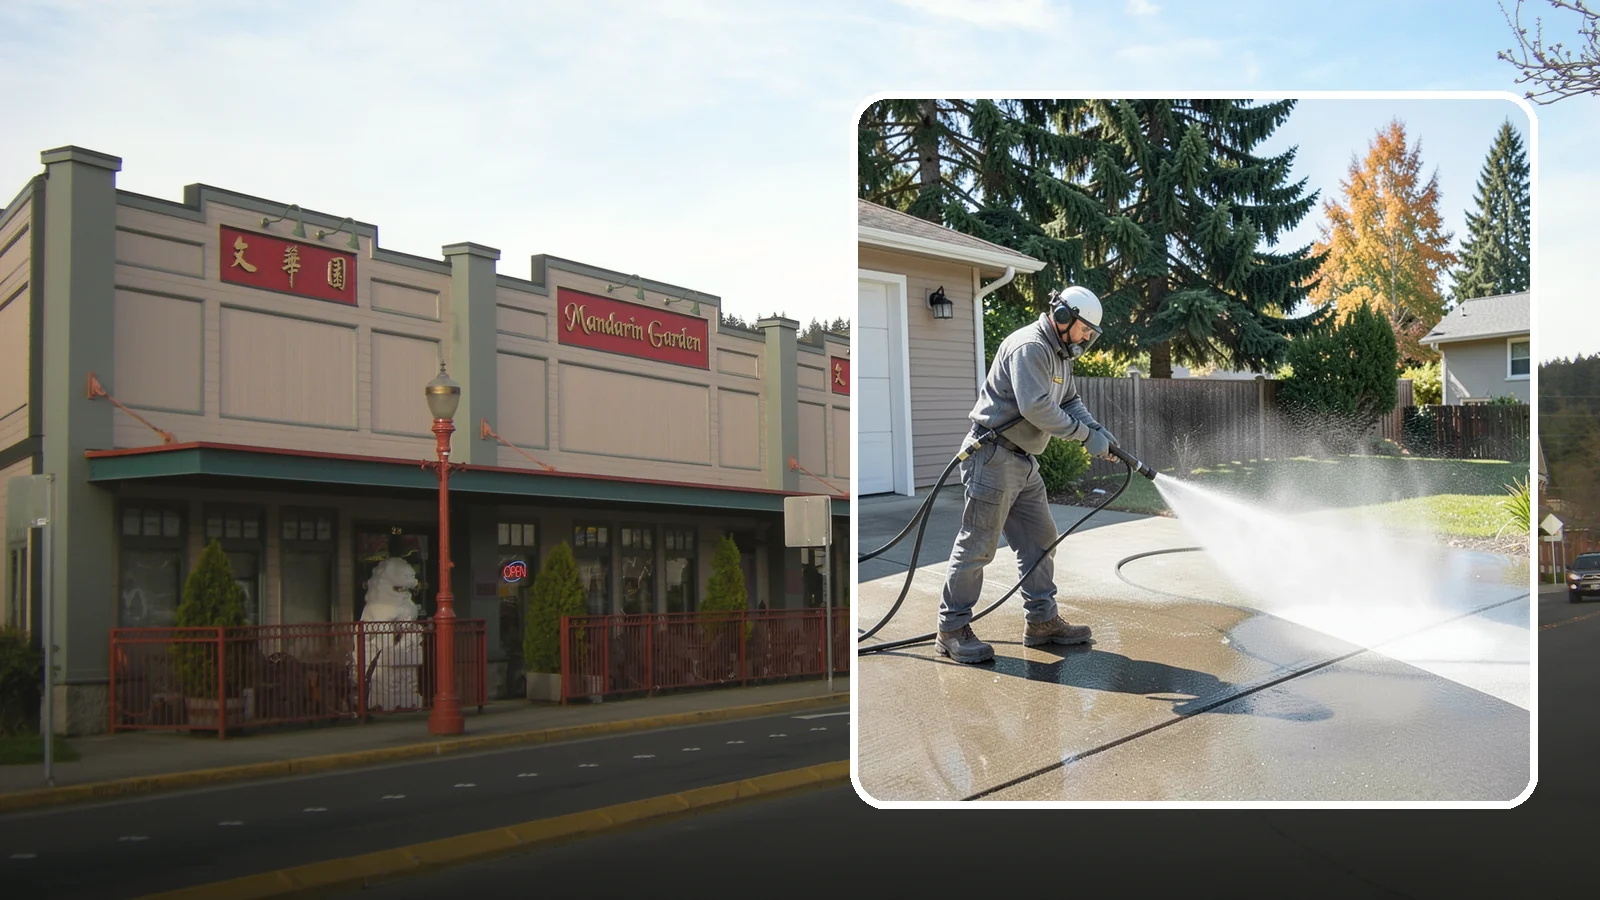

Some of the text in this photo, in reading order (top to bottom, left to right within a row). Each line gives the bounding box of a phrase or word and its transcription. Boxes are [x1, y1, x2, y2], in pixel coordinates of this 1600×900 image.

[565, 302, 701, 352] Mandarin Garden
[503, 565, 527, 578] OPEN
